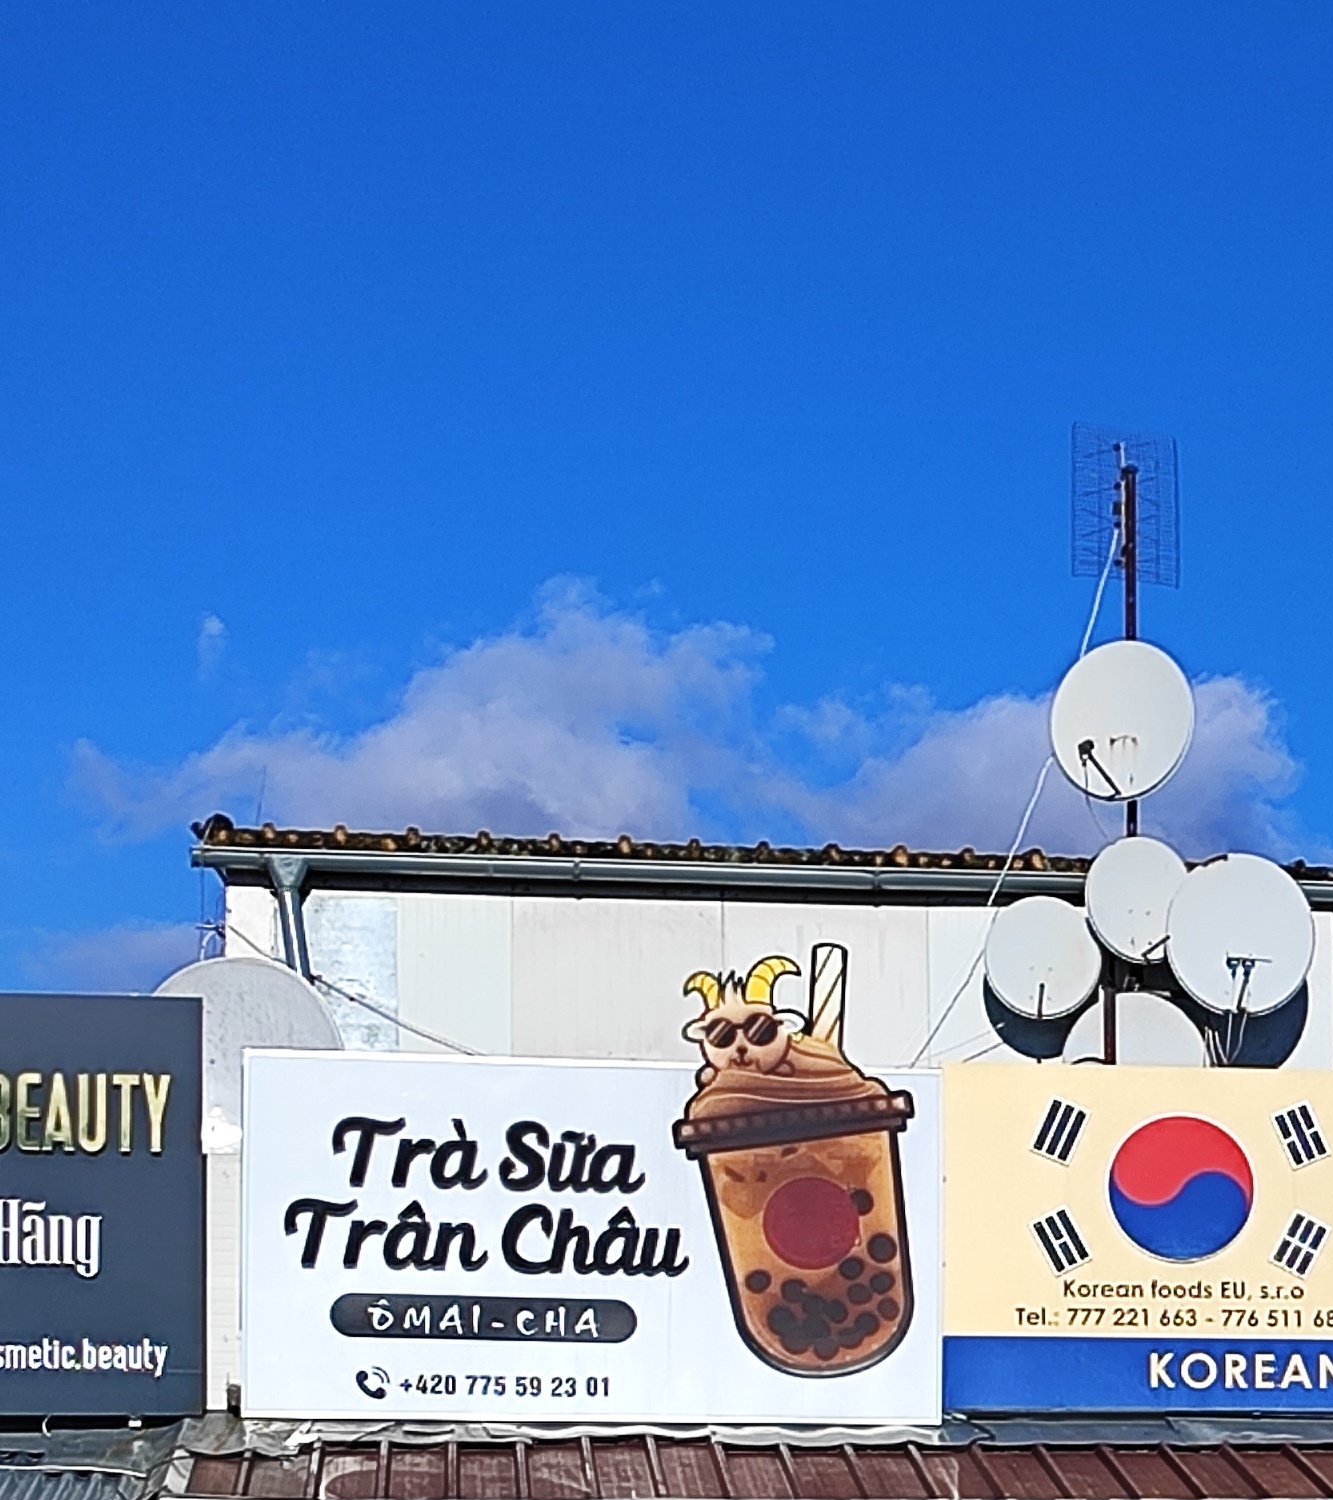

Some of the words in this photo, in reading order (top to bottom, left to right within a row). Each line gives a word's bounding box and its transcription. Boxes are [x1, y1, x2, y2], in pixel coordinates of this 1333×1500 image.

[332, 1116, 489, 1190] Trà
[499, 1120, 646, 1194] Sữa
[0, 1199, 102, 1278] Hãng
[284, 1198, 489, 1271] Trân
[502, 1203, 690, 1277] Châu
[1063, 1279, 1144, 1300] Korean
[1151, 1279, 1213, 1300] foods
[1015, 1307, 1060, 1327] Tel.:
[1067, 1308, 1103, 1327] 777
[1113, 1308, 1150, 1327] 221
[1159, 1309, 1197, 1328] 663
[1221, 1309, 1259, 1328] 776
[1267, 1309, 1302, 1328] 511
[400, 1374, 457, 1396] +420
[465, 1374, 506, 1396] 775
[515, 1375, 542, 1397] 59
[551, 1376, 577, 1397] 23
[586, 1376, 610, 1398] 01
